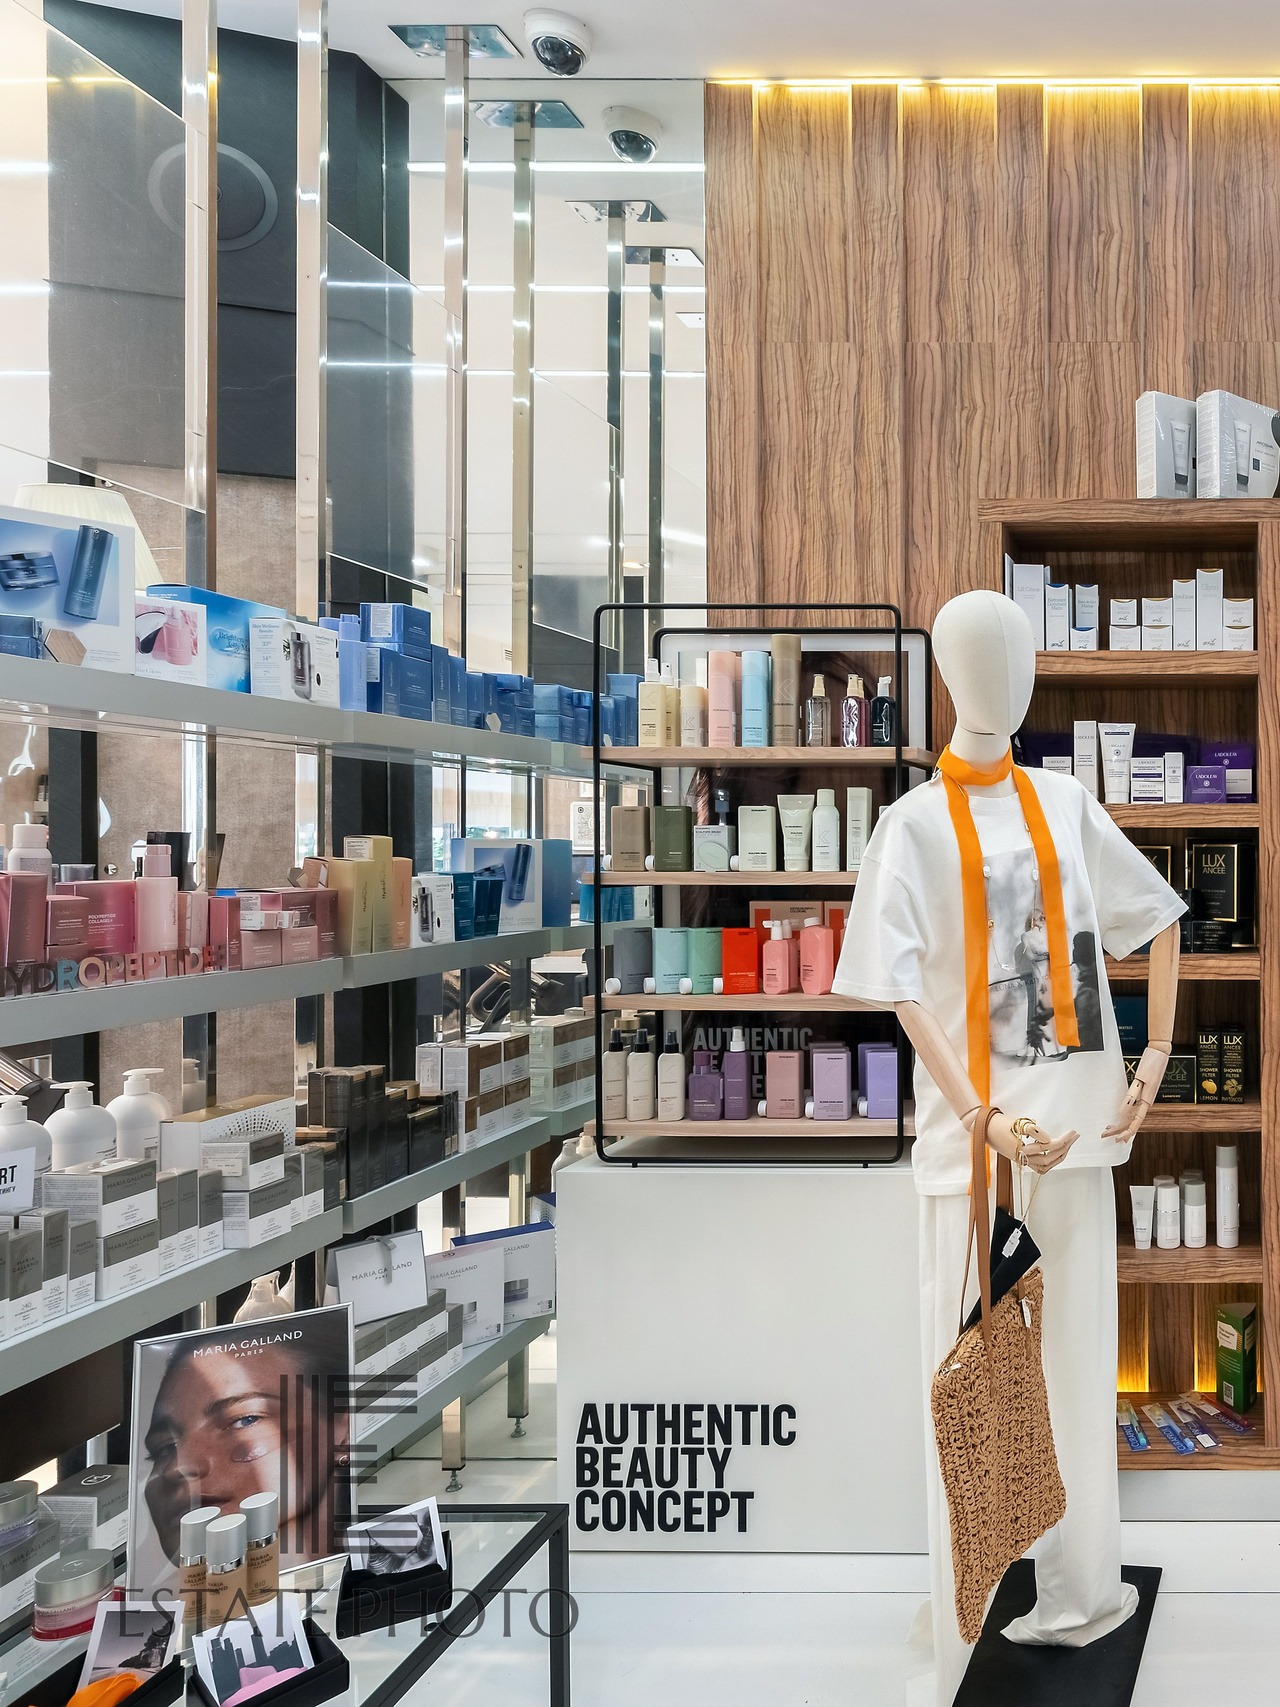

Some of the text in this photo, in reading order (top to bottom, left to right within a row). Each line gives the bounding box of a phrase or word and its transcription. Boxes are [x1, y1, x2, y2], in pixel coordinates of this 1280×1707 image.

[1201, 583, 1219, 591] Glyco
[1202, 854, 1225, 867] LUX
[1203, 867, 1226, 875] ANCEE
[0, 945, 227, 999] YDROPEPTIDE
[1199, 1035, 1218, 1044] LUX
[1223, 1036, 1242, 1045] LUX
[109, 1231, 155, 1252] MARIA GALLAND
[351, 1261, 412, 1281] MARIA GALAND
[430, 1264, 478, 1280] MARIA GALLAND
[21, 1302, 32, 1311] 240
[193, 1330, 303, 1358] MARIA GALLAND
[234, 1348, 264, 1358] PARIS
[576, 1403, 797, 1446] AUTHENTIC
[1123, 1425, 1140, 1449] CURAPRO
[576, 1446, 732, 1488] BEAUTY
[576, 1490, 755, 1532] CONCEPT
[2, 1535, 56, 1571] MARIA GALLAND
[250, 1553, 269, 1562] MARIA
[184, 1575, 206, 1583] GALLAN
